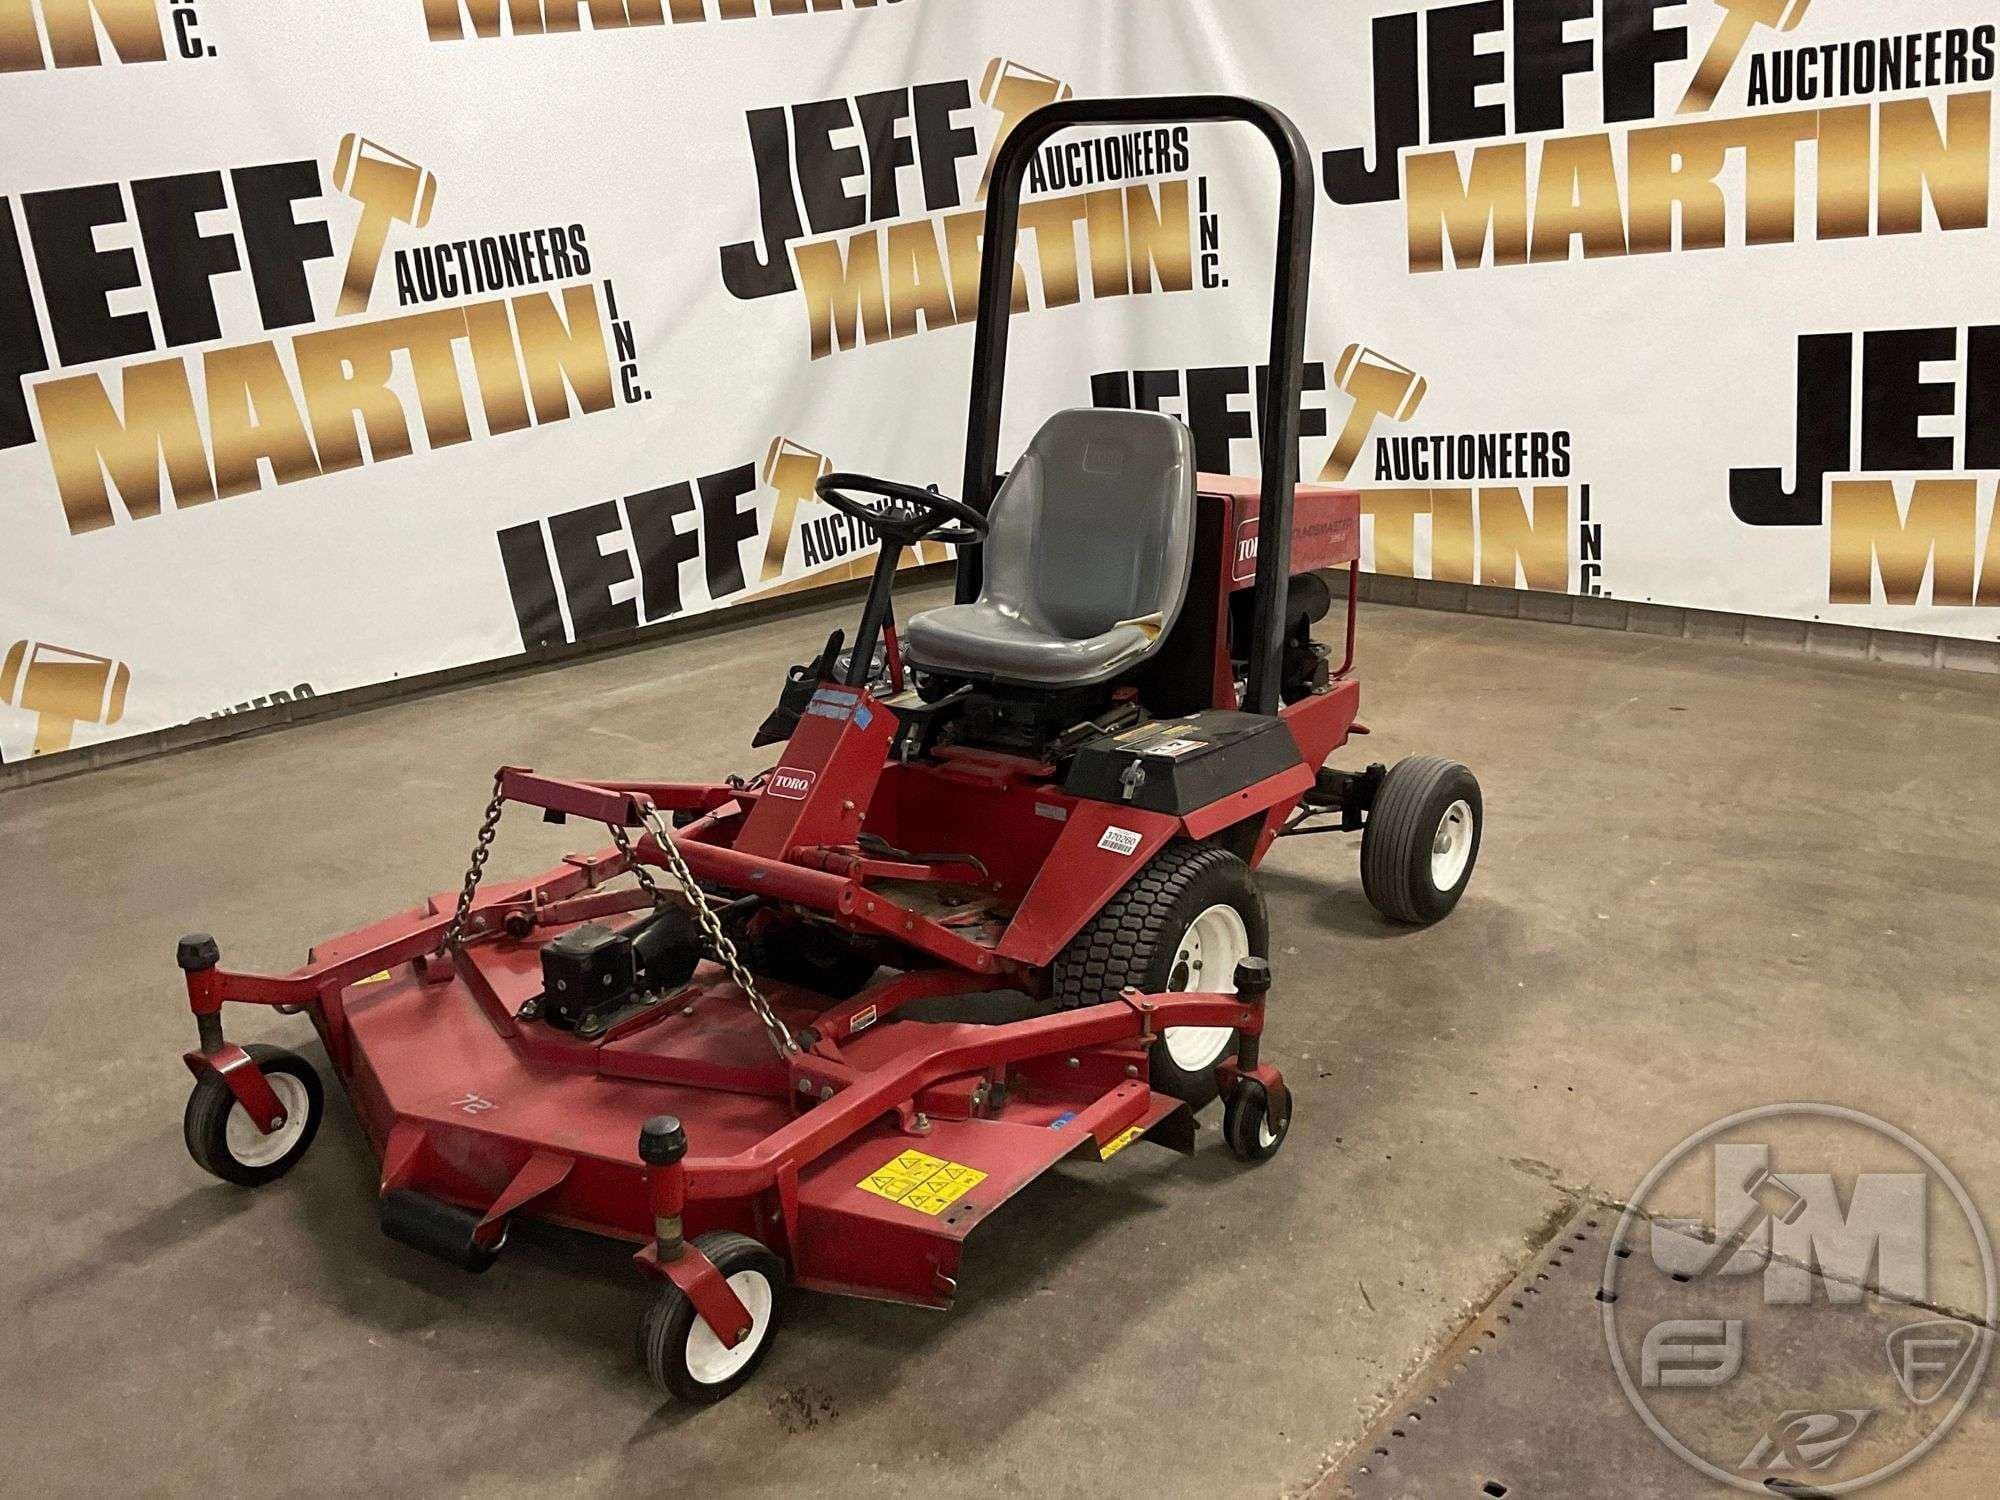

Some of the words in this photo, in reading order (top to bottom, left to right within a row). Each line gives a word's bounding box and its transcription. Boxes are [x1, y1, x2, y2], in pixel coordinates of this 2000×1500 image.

[1322, 0, 1688, 205] JEFF
[1747, 25, 1996, 107] AUCTIONEERS
[720, 79, 977, 300] JEFF
[1030, 127, 1189, 194] AUCTIONEERS
[1405, 89, 1991, 274] MARTIN
[395, 224, 591, 306] AUCTIONEERS
[793, 180, 1193, 361] MARTIN
[1199, 176, 1229, 289] INC.
[603, 279, 652, 404] INC.
[33, 284, 615, 535] MARTIN
[1375, 430, 1571, 482] AUCTIONEERS
[1360, 486, 1568, 594] TIN
[775, 775, 809, 791] TORO
[1105, 831, 1137, 846] 370260
